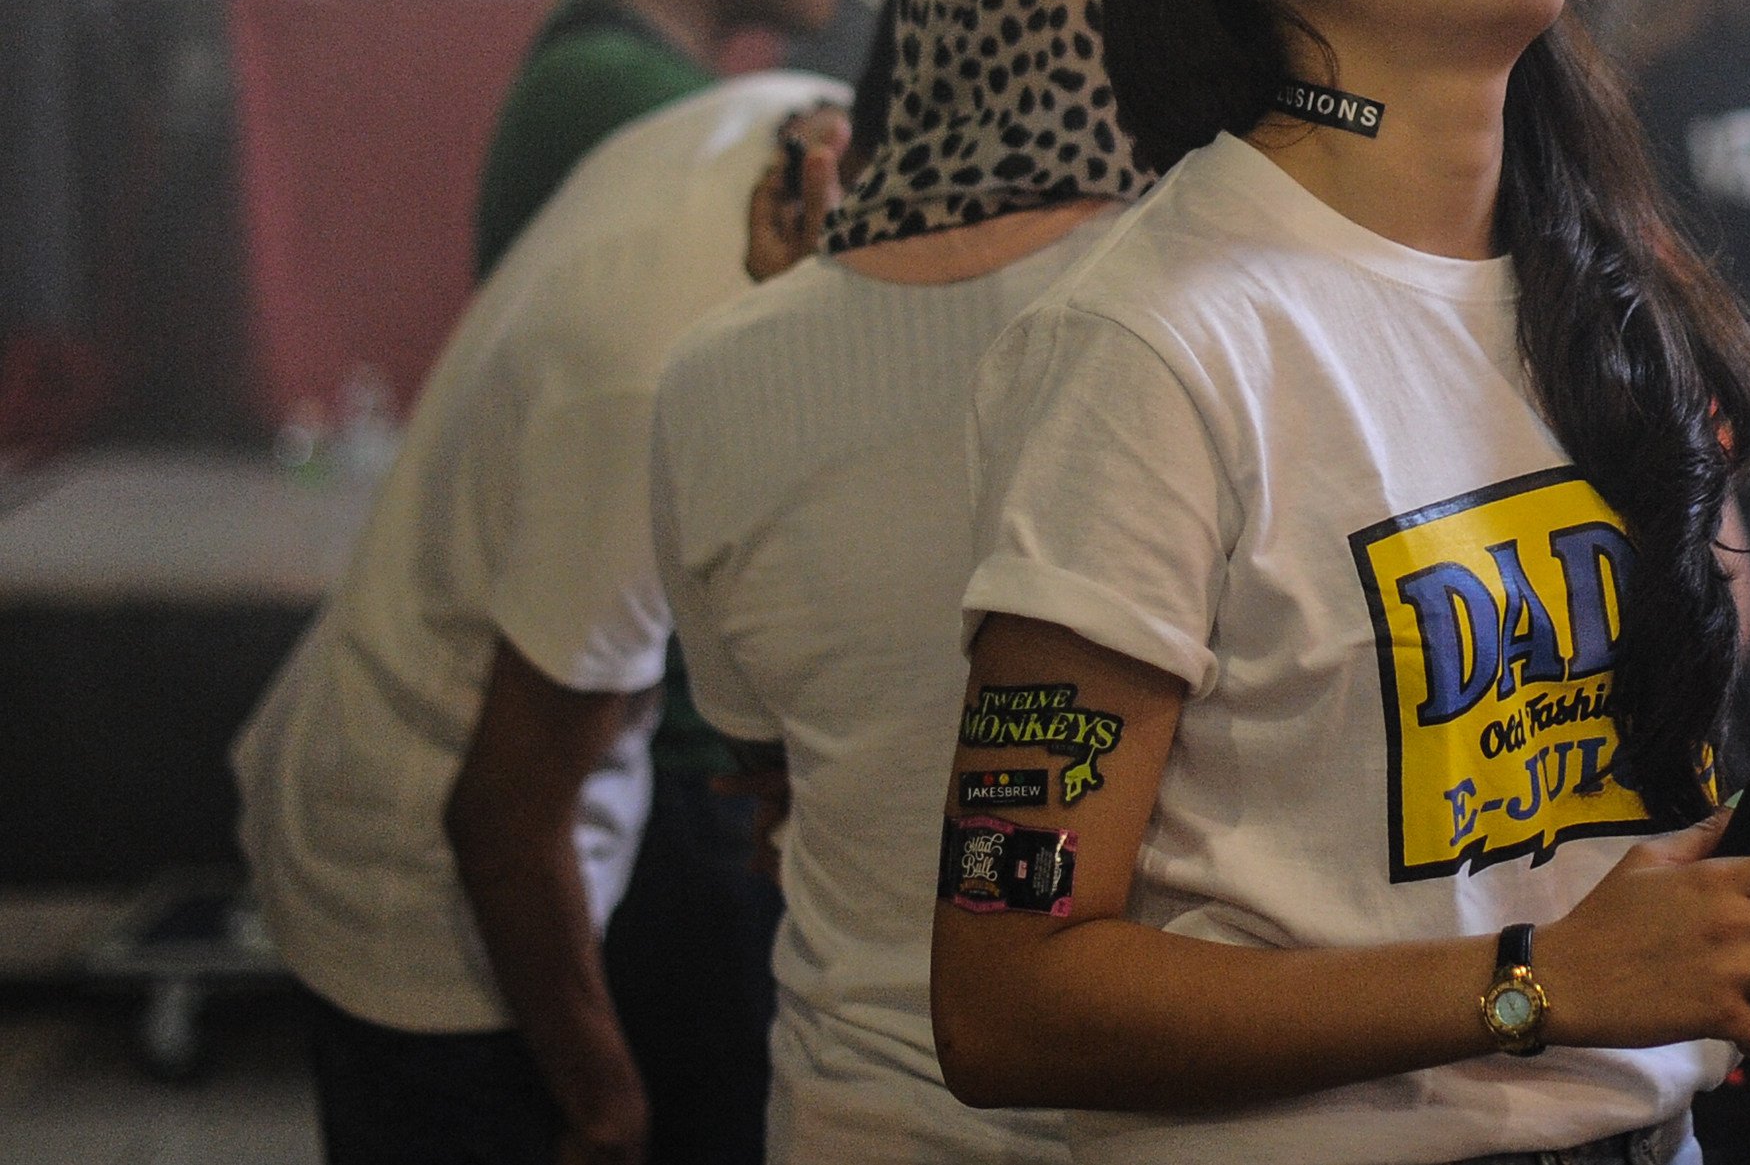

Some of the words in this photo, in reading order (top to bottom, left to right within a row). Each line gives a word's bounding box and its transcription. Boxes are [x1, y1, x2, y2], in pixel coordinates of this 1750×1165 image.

[981, 689, 1071, 717] TWELVE
[961, 710, 1118, 750] MONKEYS
[1480, 708, 1526, 759] Old
[967, 785, 1041, 801] JAKESBREW
[961, 853, 998, 882] Bull
